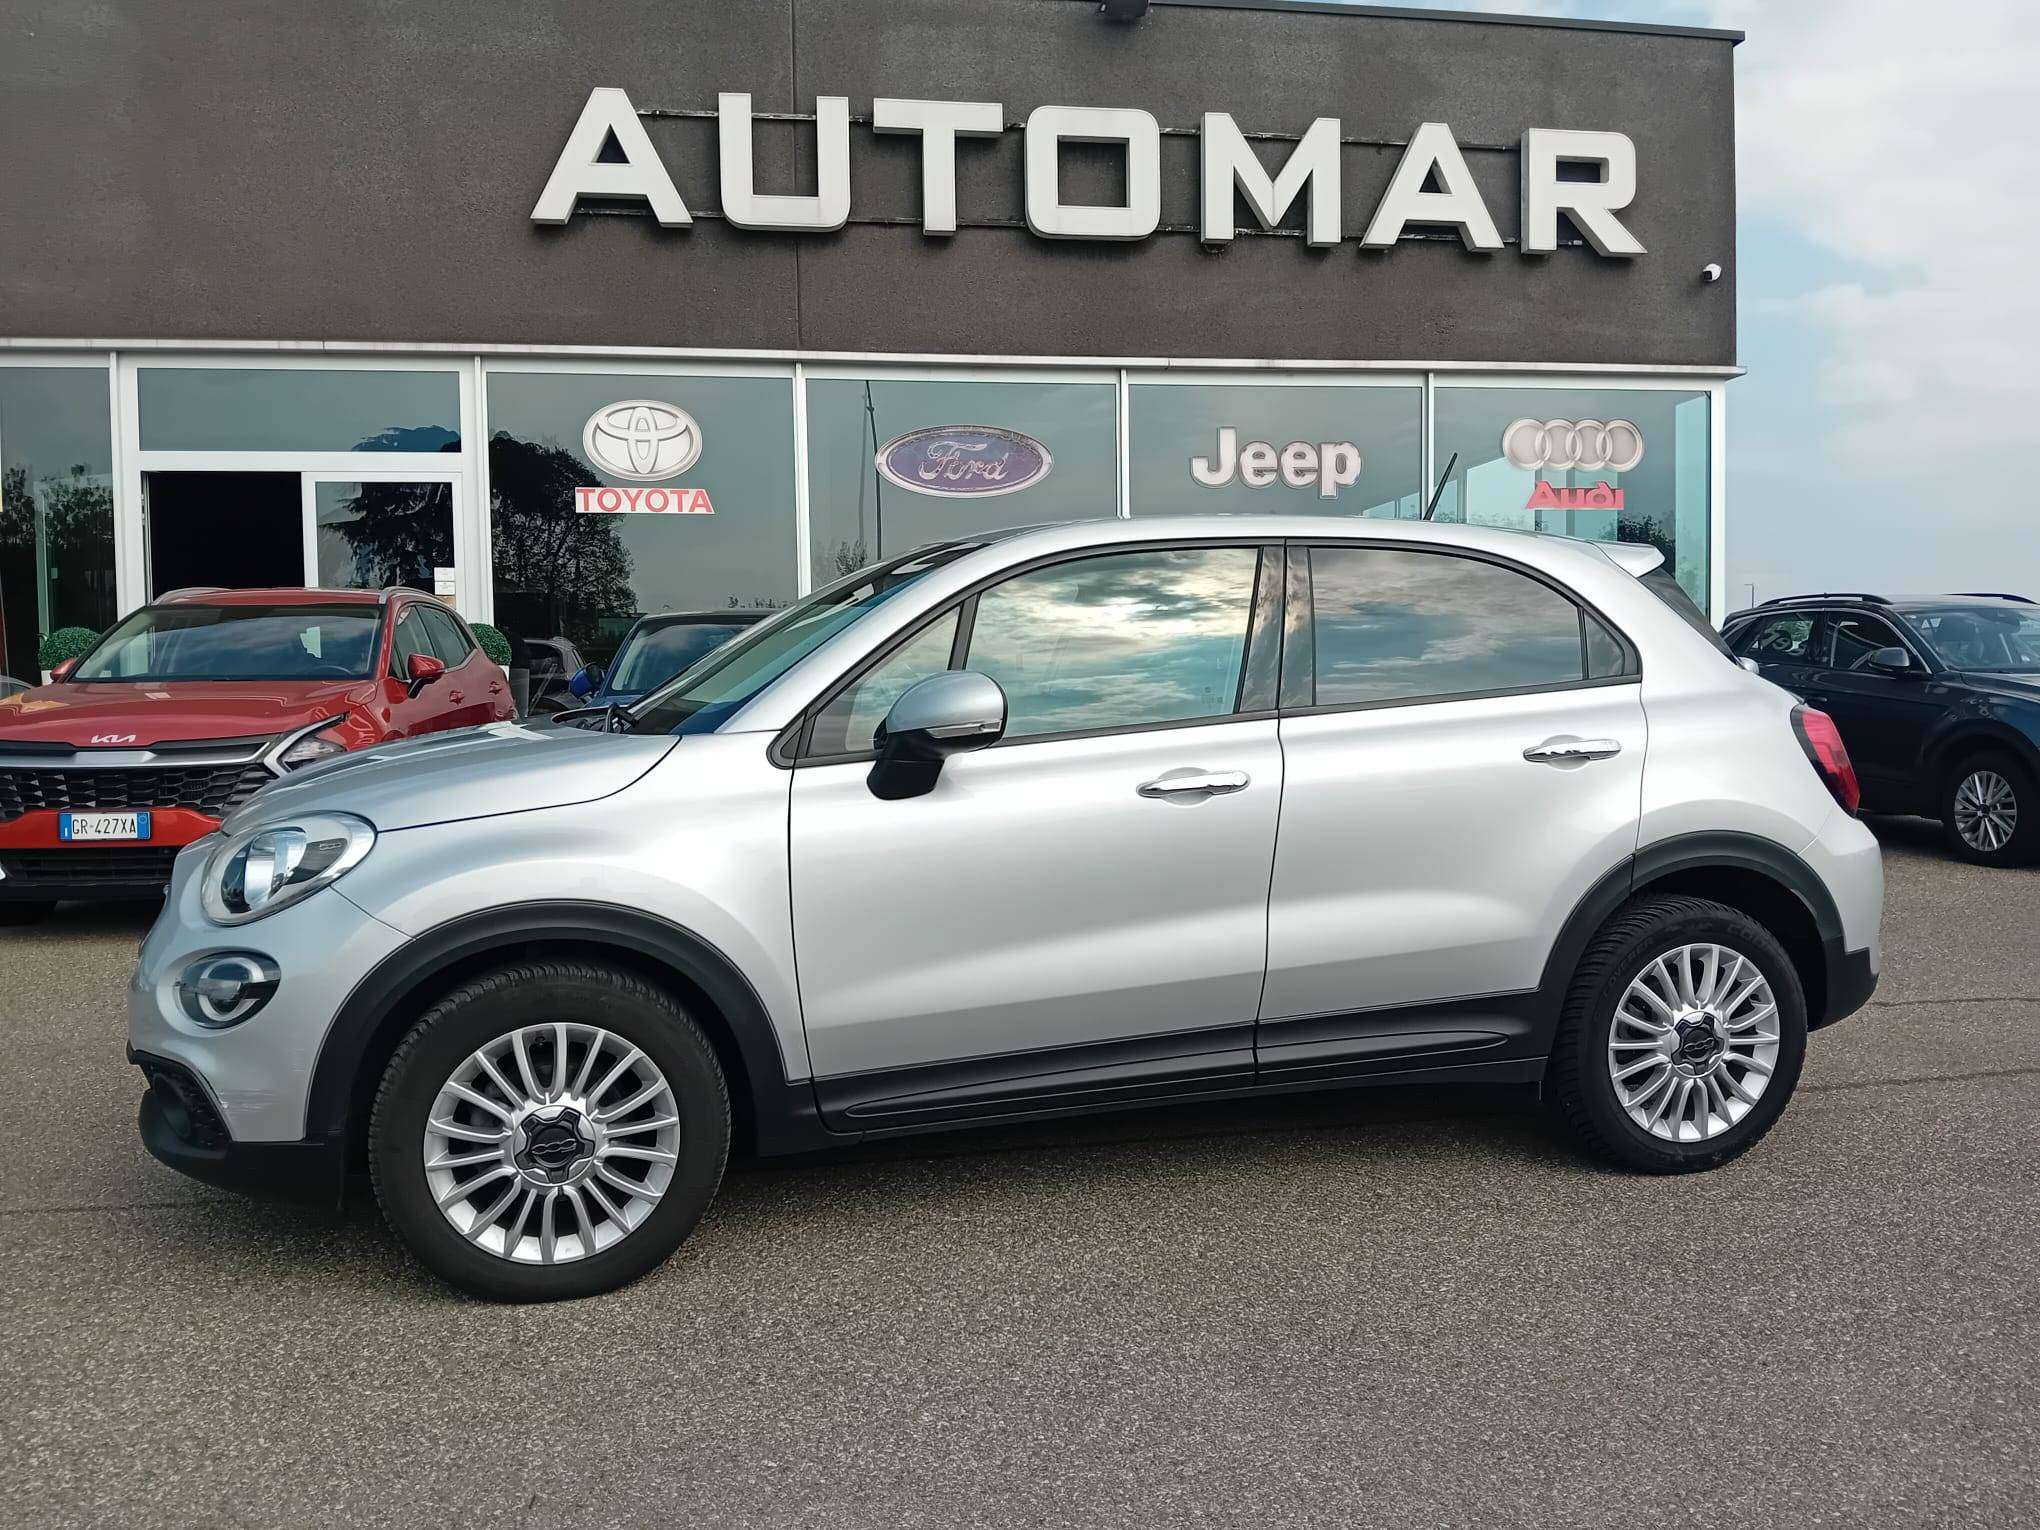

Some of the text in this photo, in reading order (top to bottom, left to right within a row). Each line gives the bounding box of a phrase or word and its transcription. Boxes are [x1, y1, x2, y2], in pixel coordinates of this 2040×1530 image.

[530, 86, 1648, 257] AUTOMAR
[918, 441, 1009, 480] Ford
[1189, 426, 1363, 500] Jeep
[576, 488, 713, 512] TOYOTA
[1525, 480, 1624, 509] Audi
[72, 818, 88, 835] GR
[95, 818, 137, 834] 427XA
